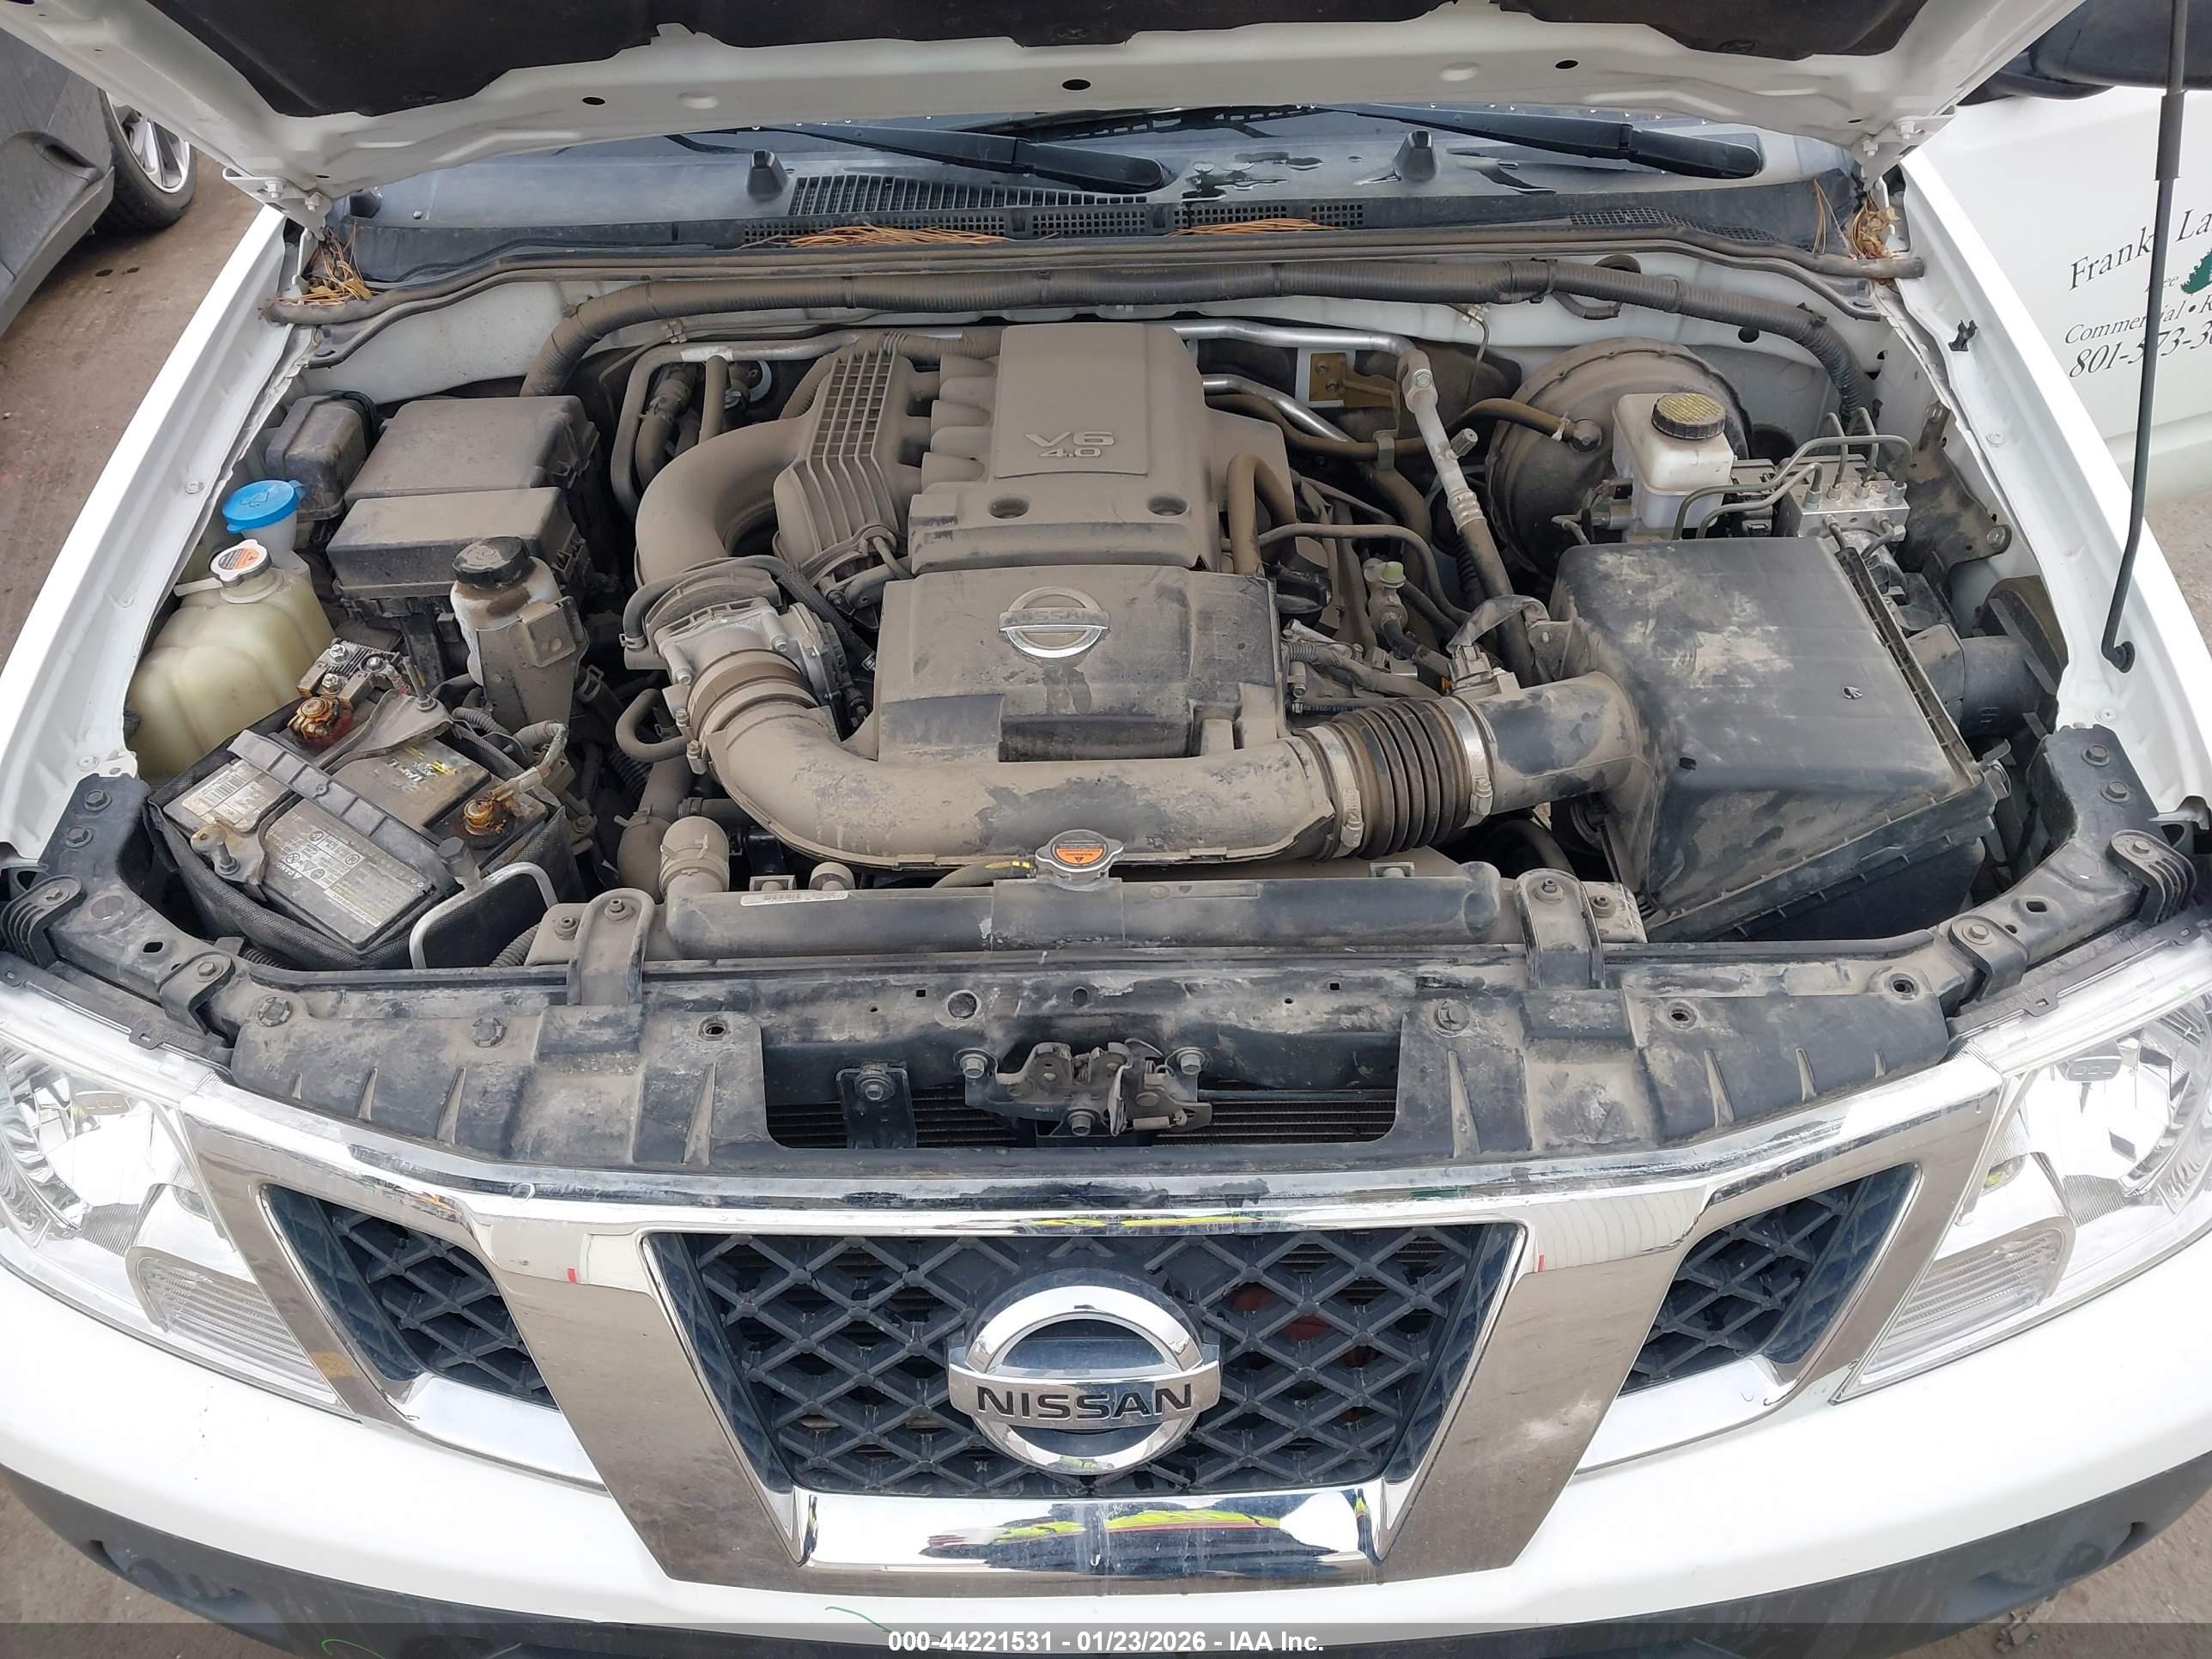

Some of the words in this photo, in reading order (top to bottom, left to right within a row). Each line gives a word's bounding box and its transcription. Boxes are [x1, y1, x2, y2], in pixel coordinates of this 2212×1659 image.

[2175, 208, 2212, 242] La
[2065, 300, 2186, 344] Commerial
[2069, 320, 2212, 377] 801-573-3
[1024, 431, 1115, 447] V6
[1040, 447, 1101, 457] 4.0
[977, 1383, 1192, 1419] NISSAN
